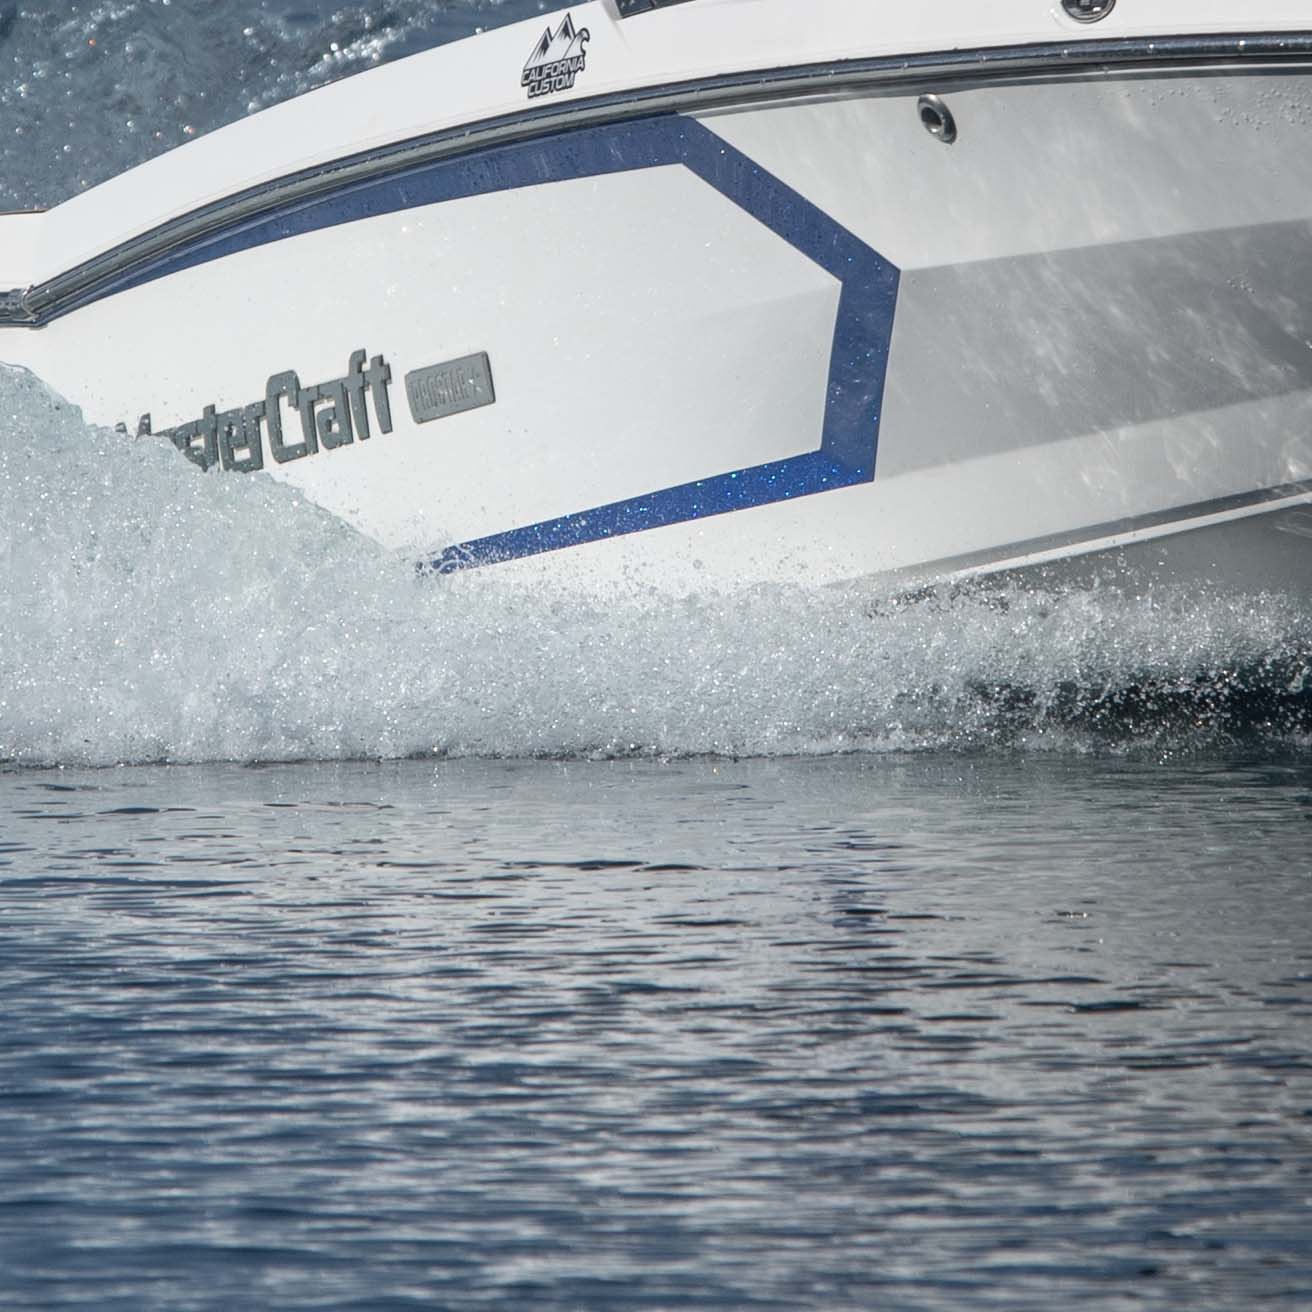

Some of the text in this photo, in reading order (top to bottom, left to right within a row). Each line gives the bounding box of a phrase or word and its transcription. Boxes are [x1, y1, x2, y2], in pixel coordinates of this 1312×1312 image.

[520, 55, 586, 86] CALIFORNIA
[527, 73, 576, 98] CUSTOM
[114, 348, 392, 473] sterCraft
